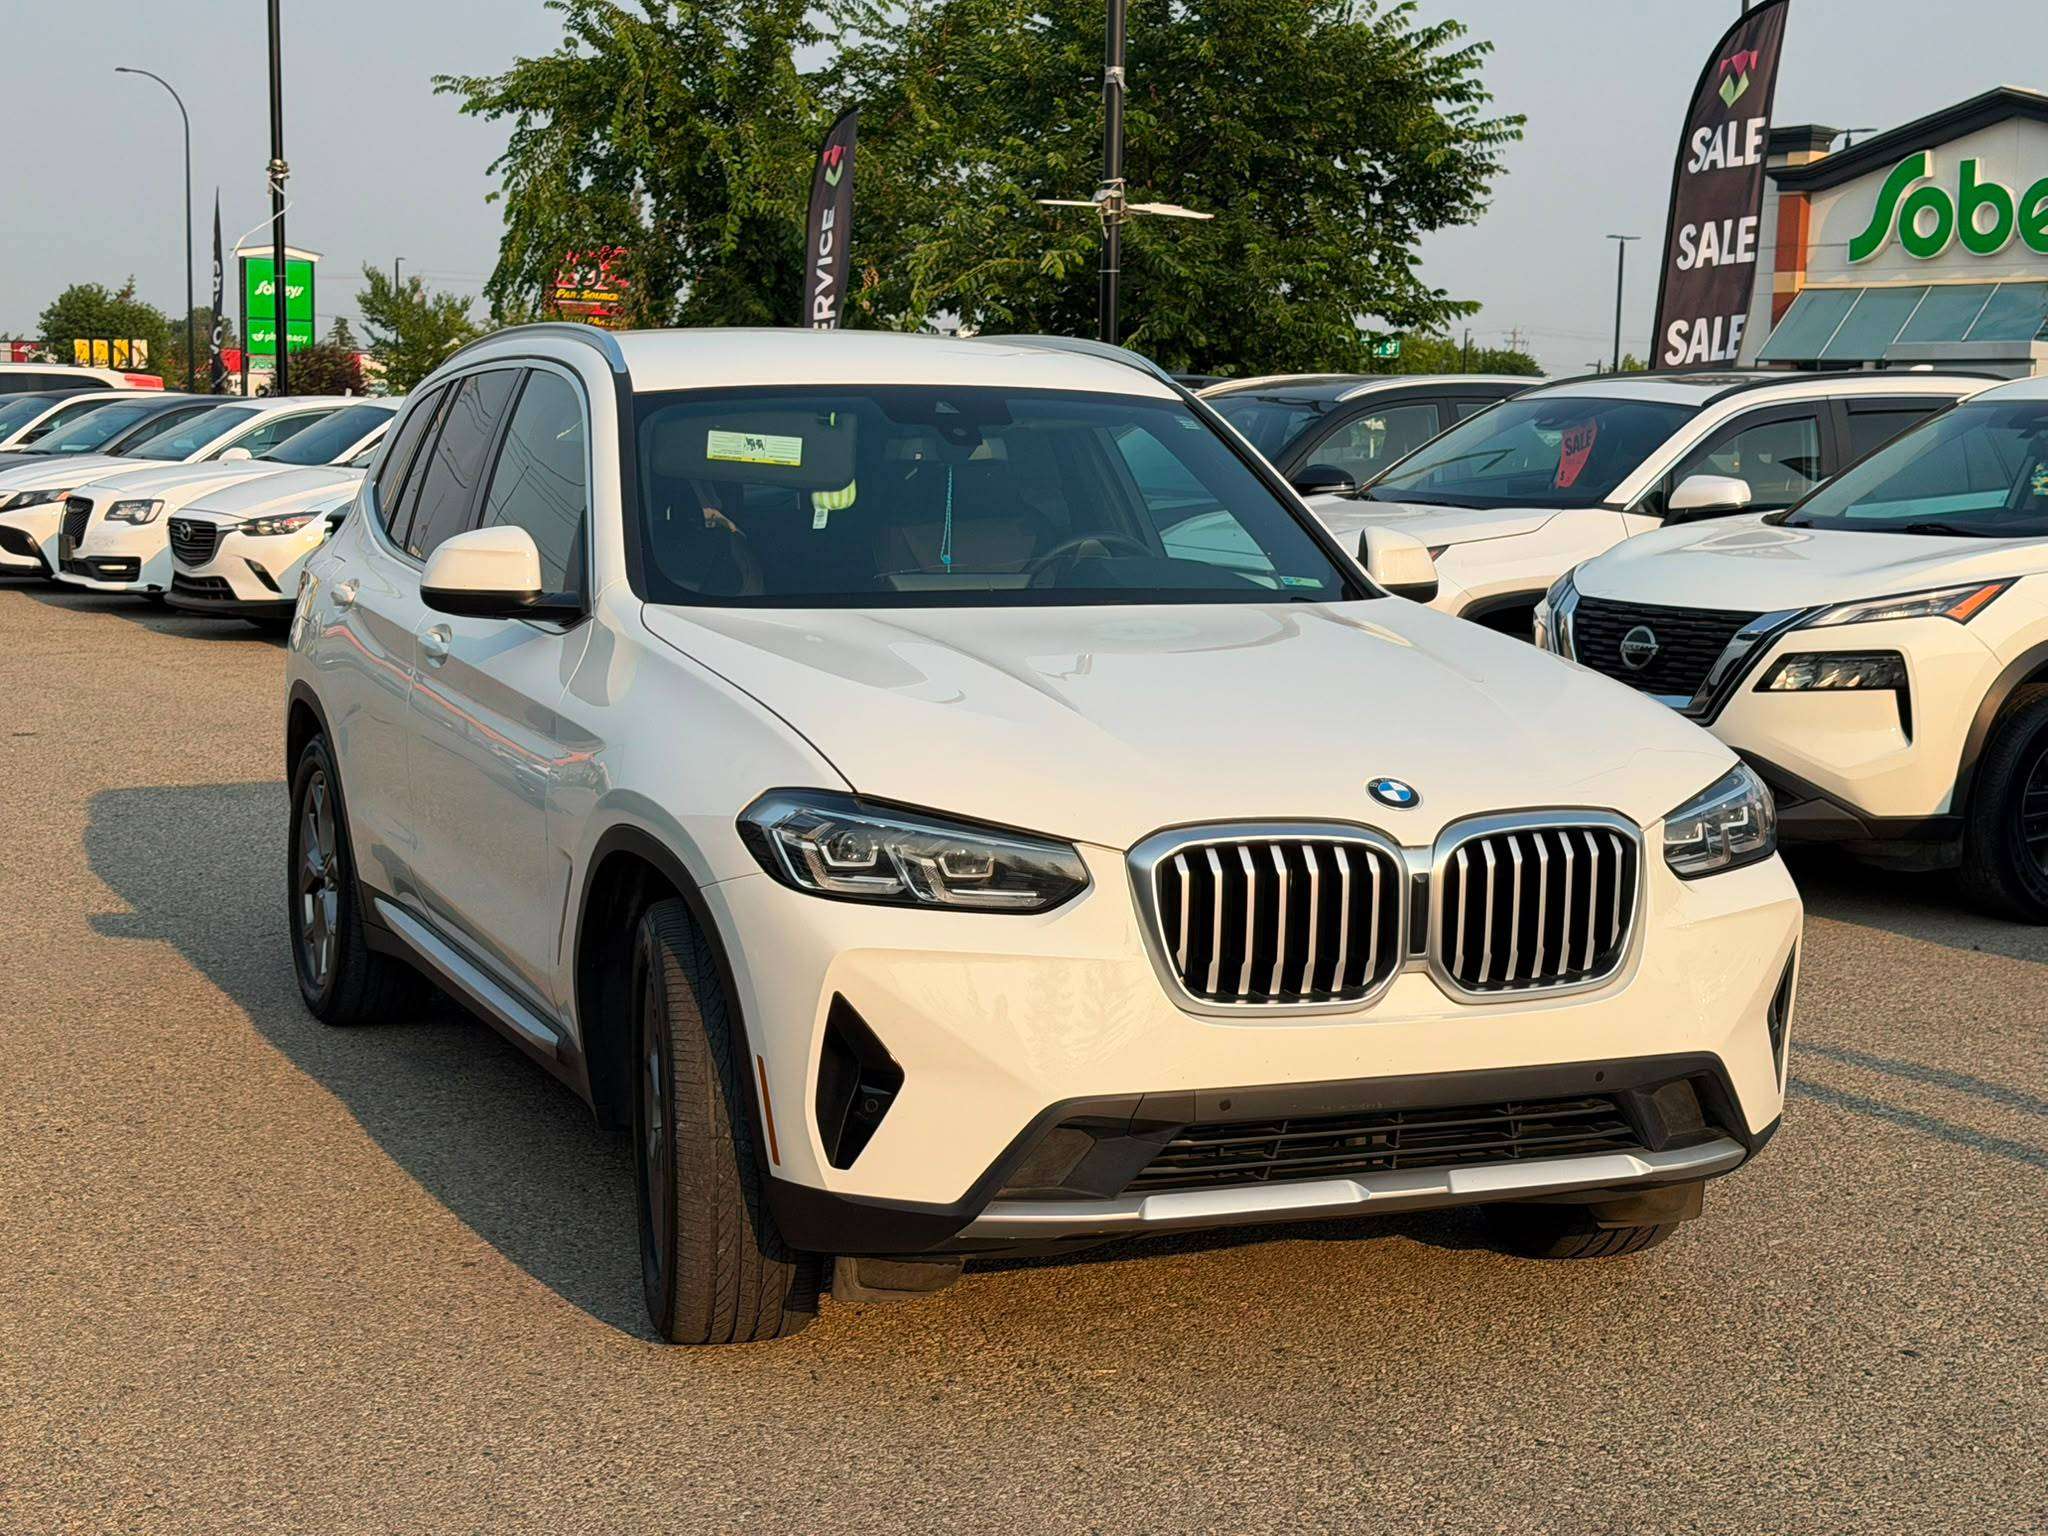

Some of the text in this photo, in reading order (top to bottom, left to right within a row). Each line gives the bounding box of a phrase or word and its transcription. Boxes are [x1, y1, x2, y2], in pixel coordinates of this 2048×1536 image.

[1688, 117, 1766, 174] SALE
[1848, 149, 2048, 265] Sobe
[1676, 215, 1758, 271] SALE
[1664, 313, 1747, 366] SALE
